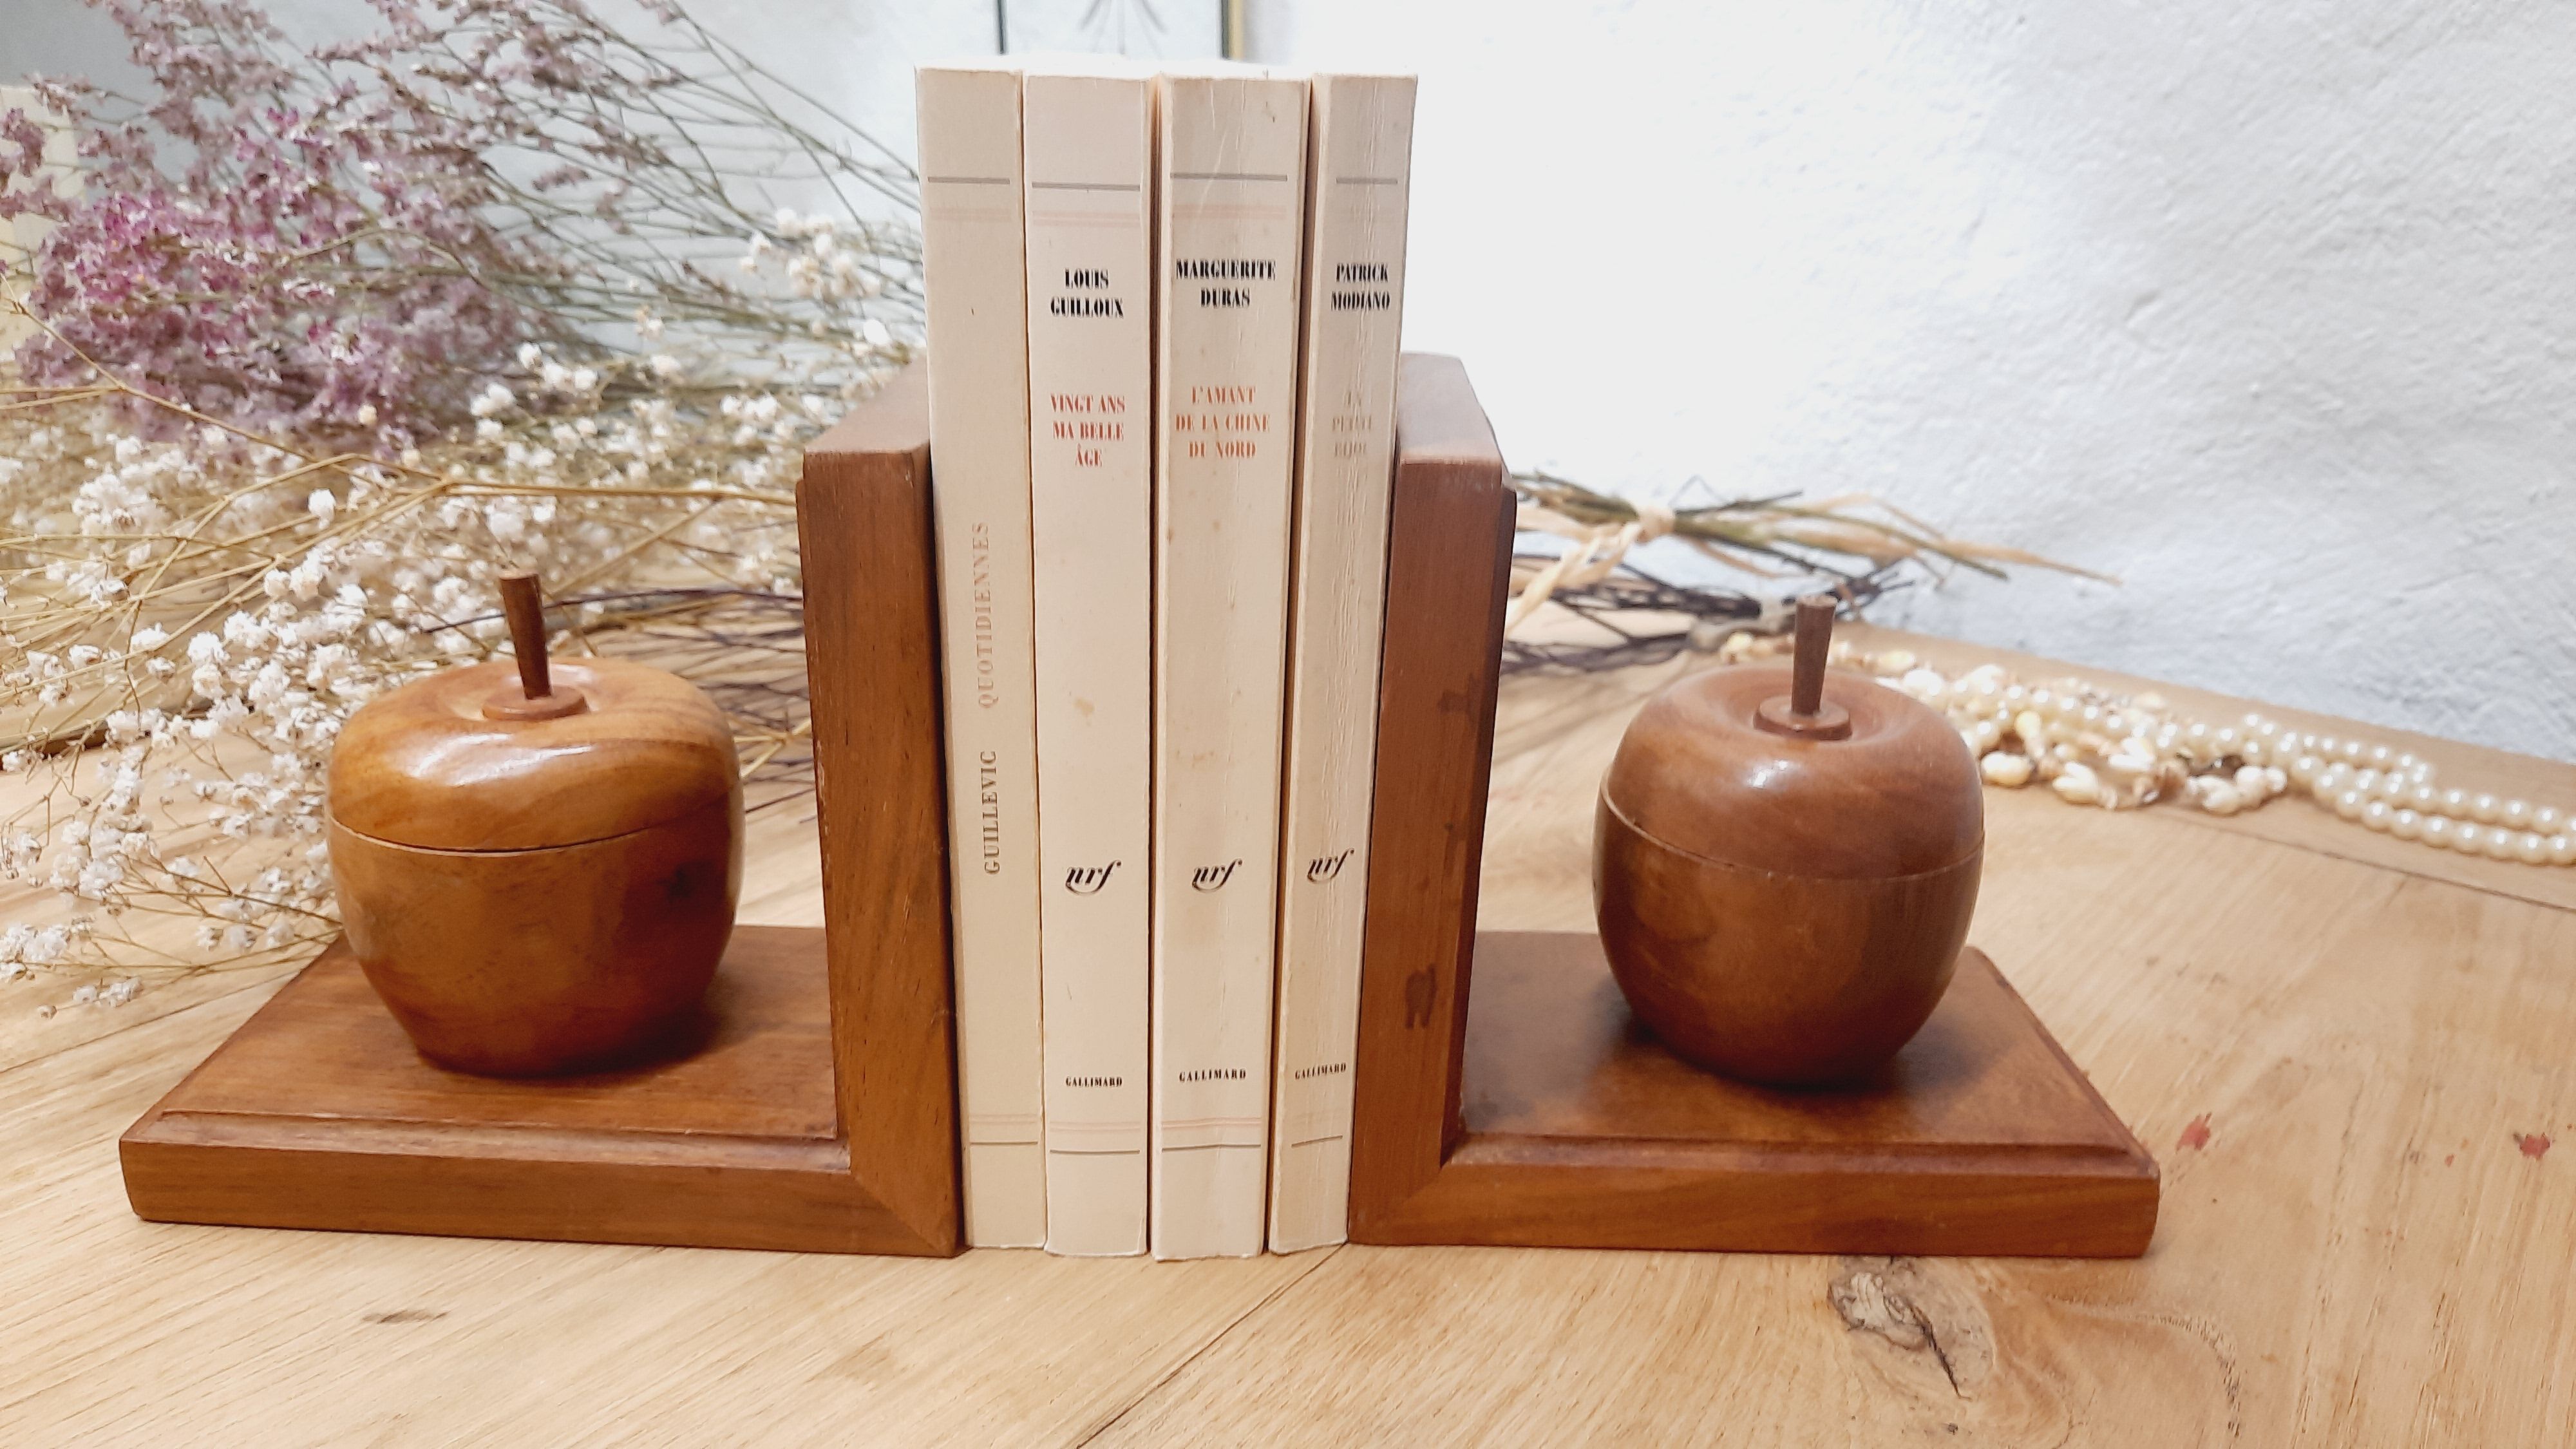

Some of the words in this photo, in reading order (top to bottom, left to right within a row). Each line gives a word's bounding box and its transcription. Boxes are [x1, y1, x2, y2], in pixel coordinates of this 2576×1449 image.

[1065, 269, 1109, 289] LOUIS
[1177, 258, 1276, 280] MARGUERITE
[1336, 263, 1388, 284] PATRICK
[1051, 298, 1124, 317] GUILLOUX
[1201, 289, 1250, 308] DURAS
[1331, 291, 1390, 311] MODIANO
[1050, 393, 1094, 413] VINGT
[1098, 394, 1125, 414] ANS
[1192, 386, 1256, 404] L'AMANT
[1053, 421, 1074, 440] MA
[1080, 421, 1124, 440] BELLE
[1176, 414, 1195, 432] DE
[1202, 414, 1219, 432] LA
[1225, 413, 1270, 432] CHINE
[1075, 442, 1103, 468] ÂGE
[1215, 440, 1256, 459] NORD
[971, 522, 999, 709] QUOTIDIENNES
[980, 751, 1001, 875] GUILLEVIC
[1191, 858, 1243, 893] nrf
[1307, 848, 1355, 884] nrf
[1065, 860, 1122, 895] nrf
[1179, 1068, 1247, 1083] GALLIMARD
[1294, 1063, 1347, 1080] GALLIMARD
[1065, 1077, 1122, 1088] GALLIMARD
